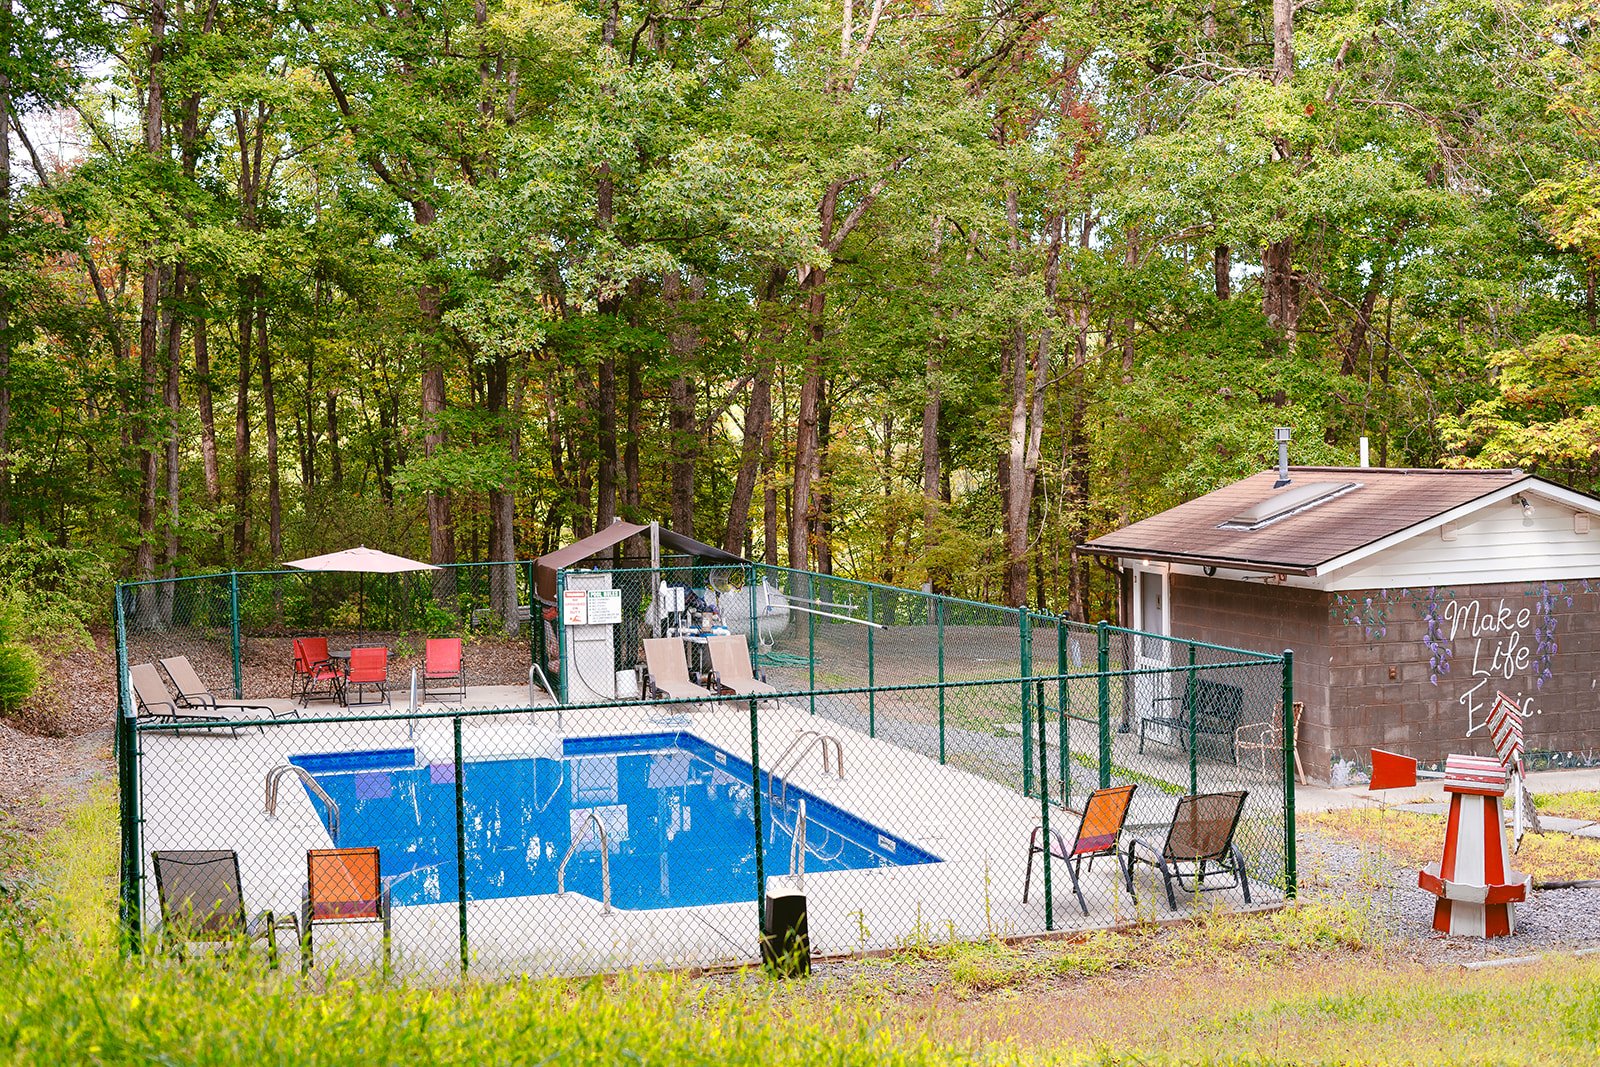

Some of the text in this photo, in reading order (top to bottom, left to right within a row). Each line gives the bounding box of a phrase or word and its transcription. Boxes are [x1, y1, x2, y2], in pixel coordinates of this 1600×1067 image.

[1444, 598, 1531, 641] Make
[1472, 631, 1531, 680] Life
[1459, 677, 1542, 738] Eic.
